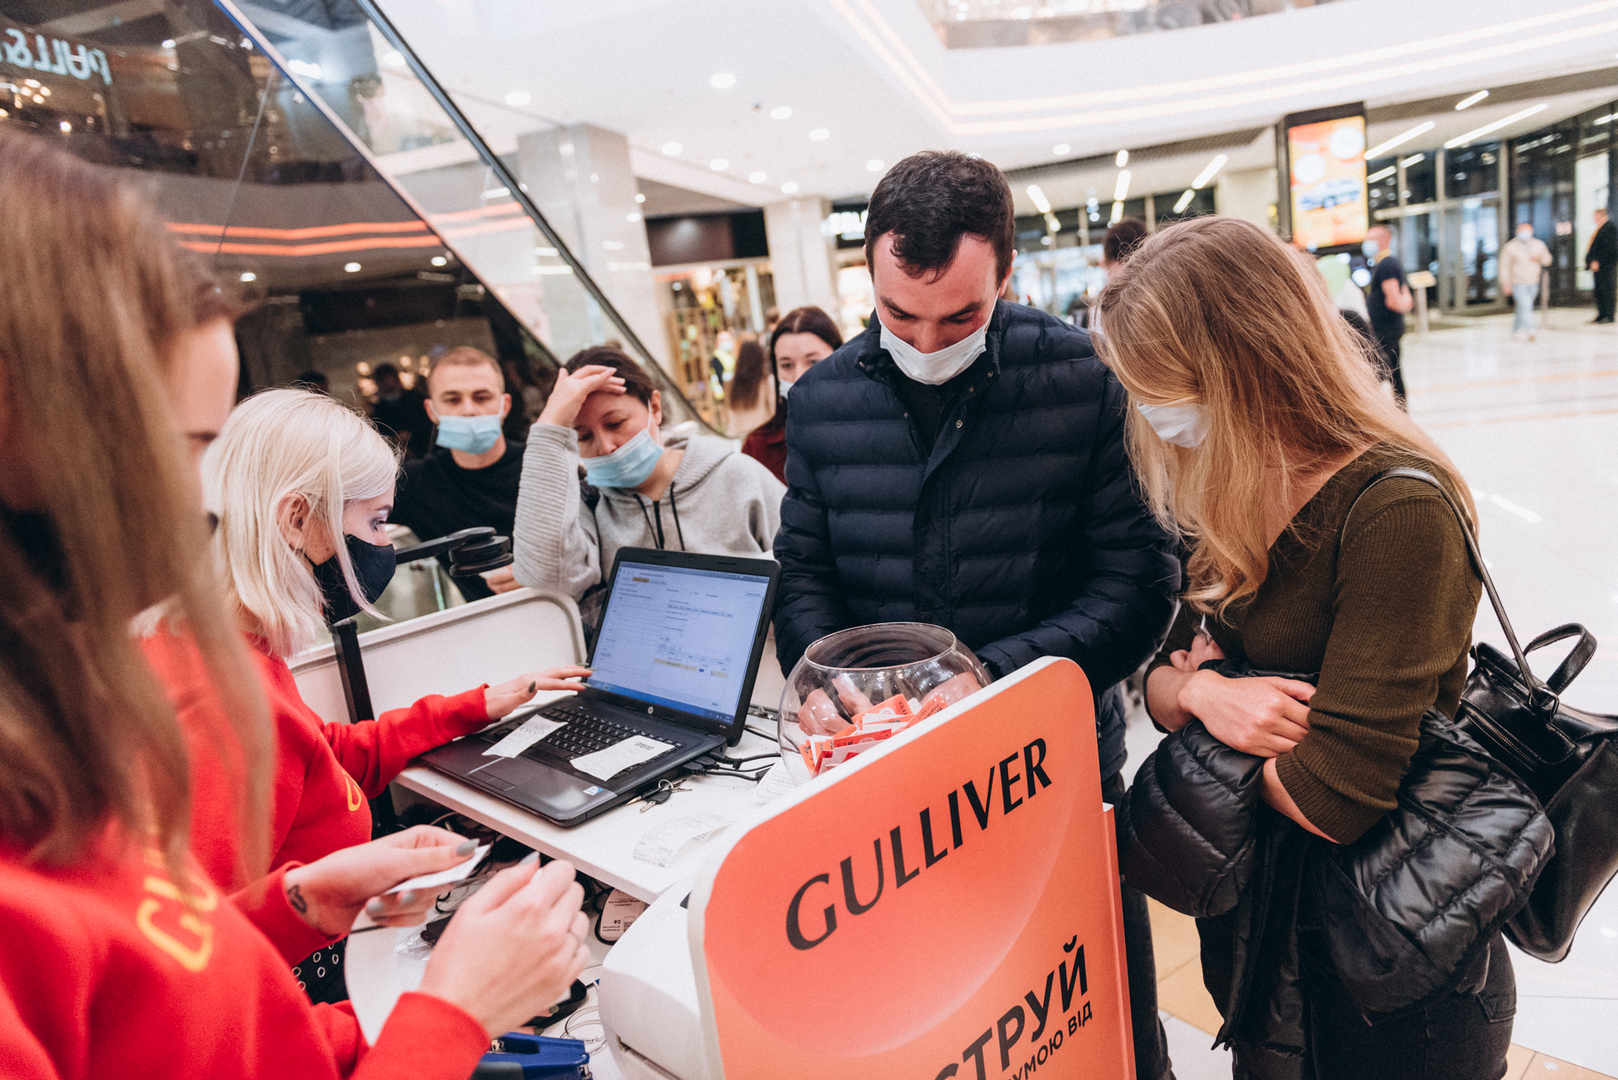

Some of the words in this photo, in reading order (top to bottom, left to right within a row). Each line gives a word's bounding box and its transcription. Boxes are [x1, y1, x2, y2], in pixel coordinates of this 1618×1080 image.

[785, 737, 1052, 951] GULLIVER
[1008, 1029, 1063, 1080] УМОЮ
[1067, 1000, 1093, 1038] ВІД
